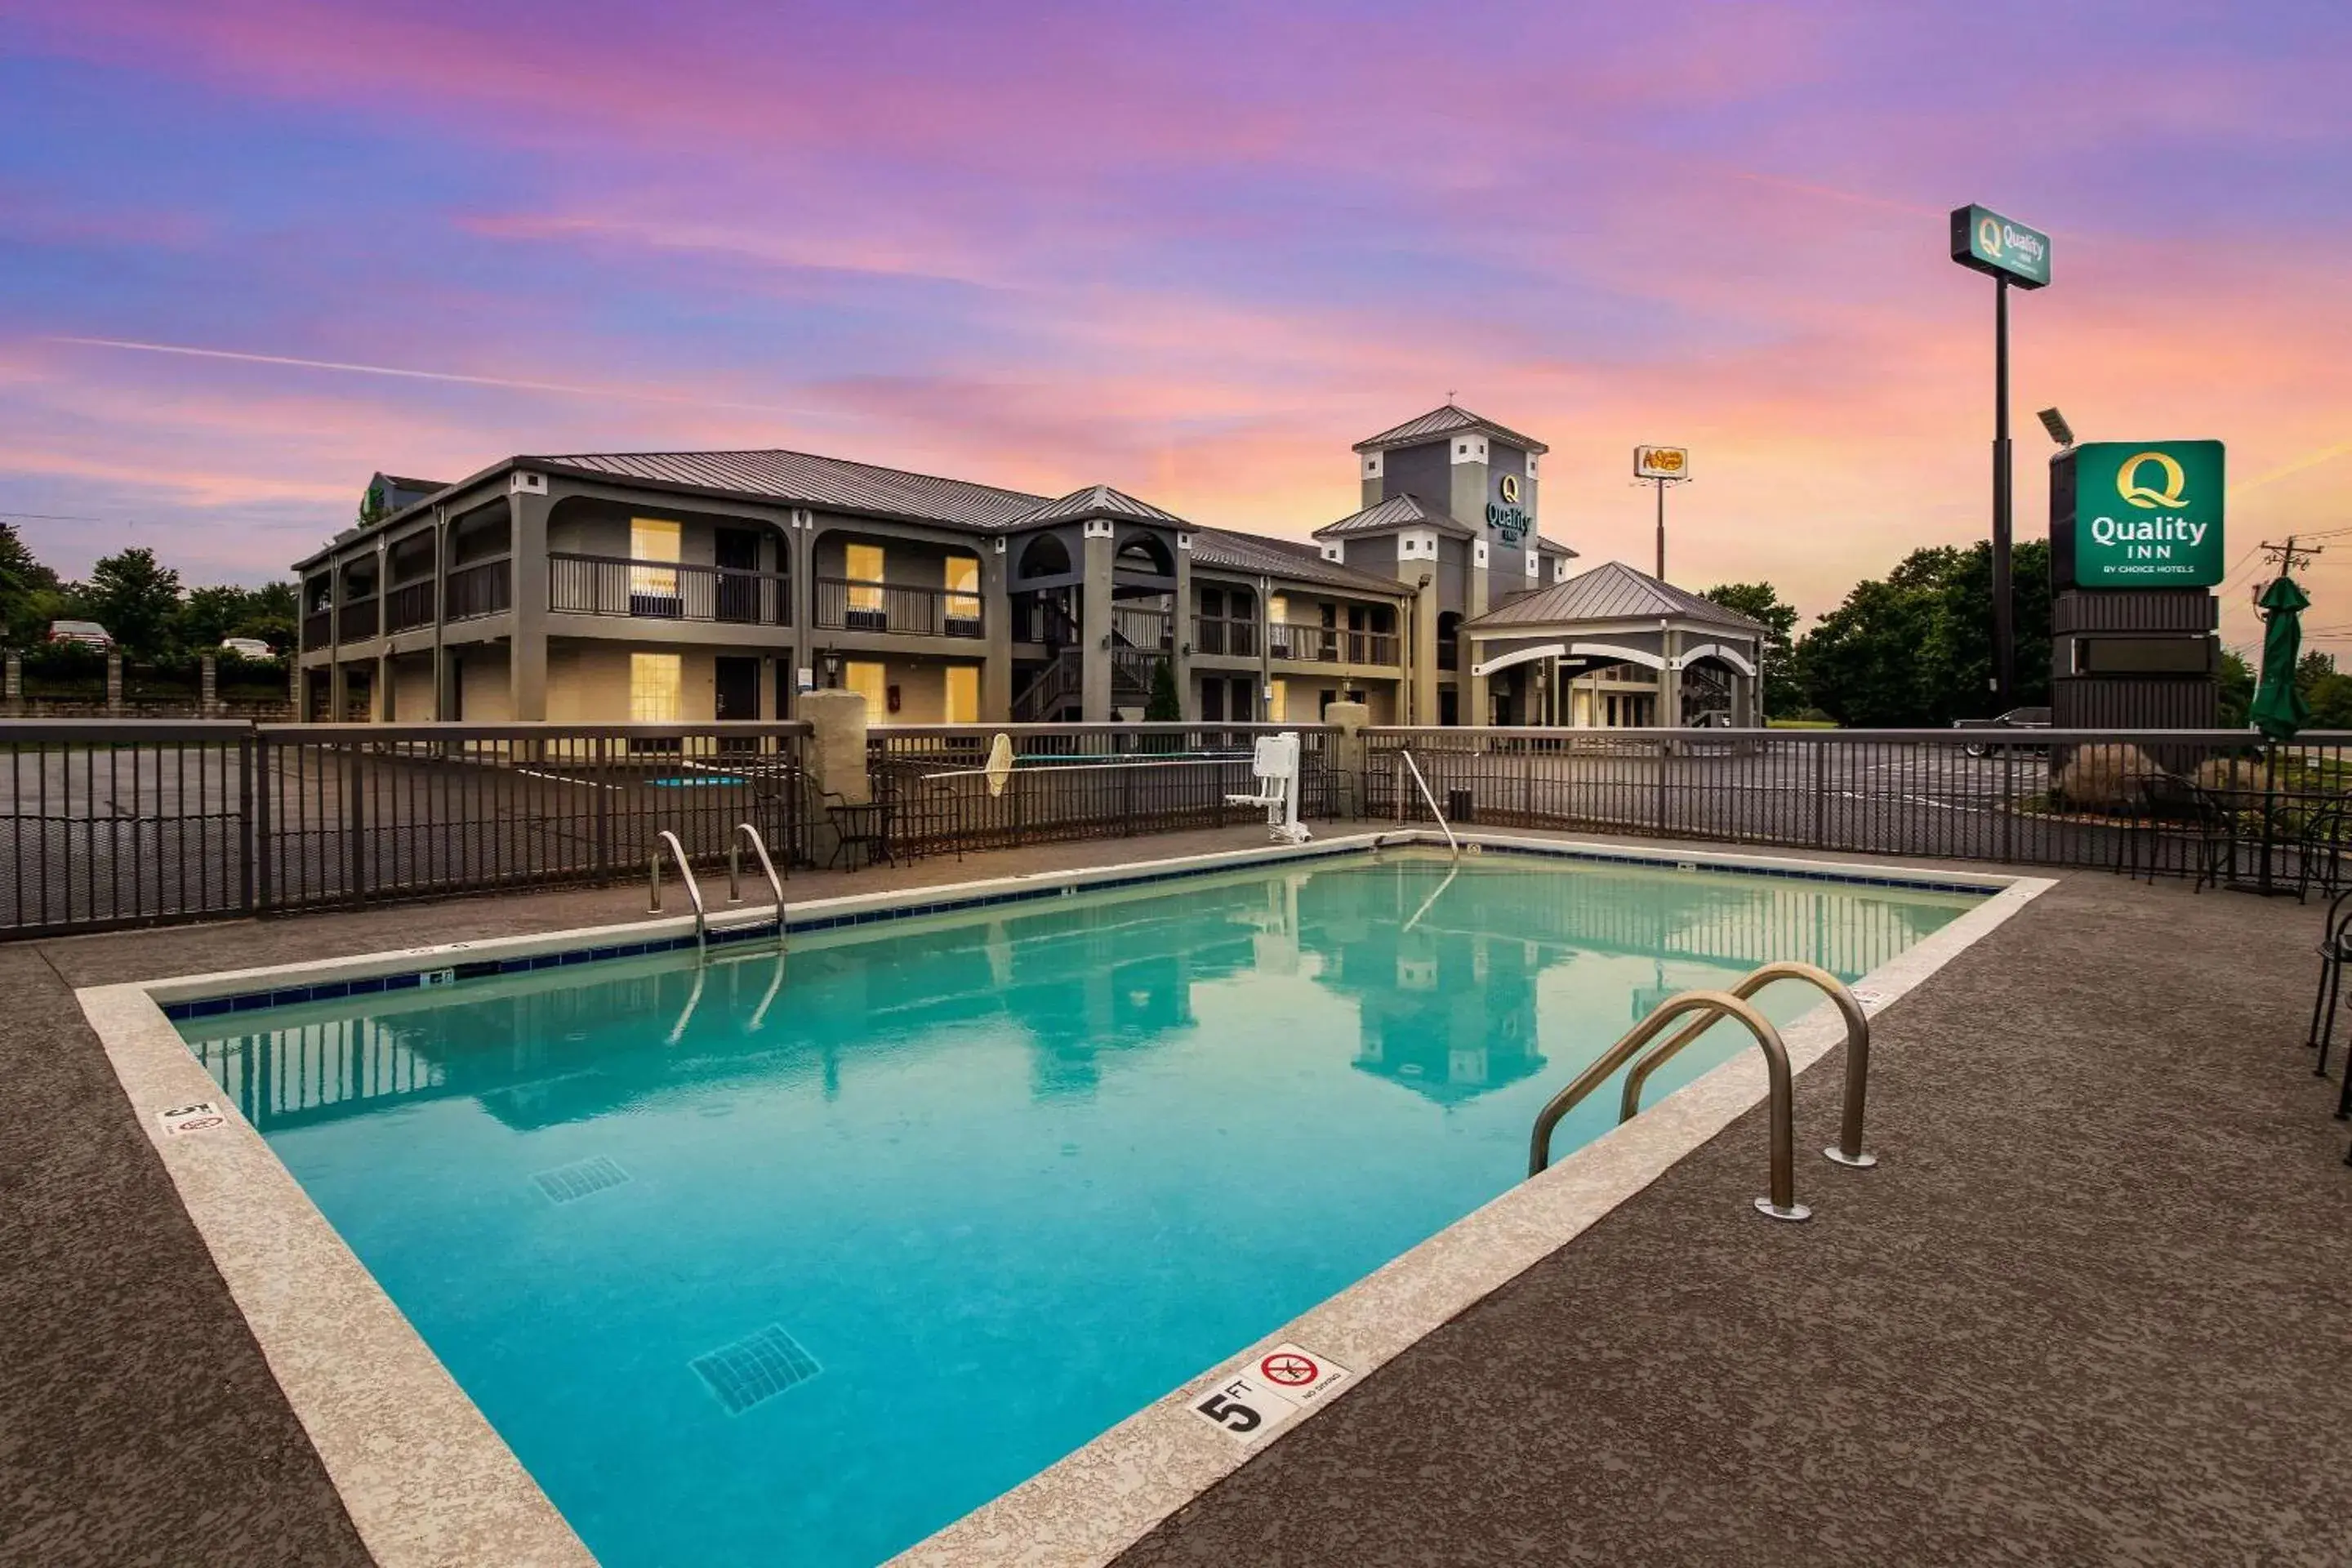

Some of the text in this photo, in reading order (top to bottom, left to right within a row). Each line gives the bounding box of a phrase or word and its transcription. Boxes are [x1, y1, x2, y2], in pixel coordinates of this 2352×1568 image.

[1980, 216, 2002, 257] Q
[1500, 474, 1519, 503] Q
[2117, 452, 2190, 509] Q
[1486, 502, 1531, 537] Quality
[2091, 516, 2207, 546] Quality
[2127, 545, 2171, 559] INN
[1196, 1379, 1262, 1432] 5 FT
